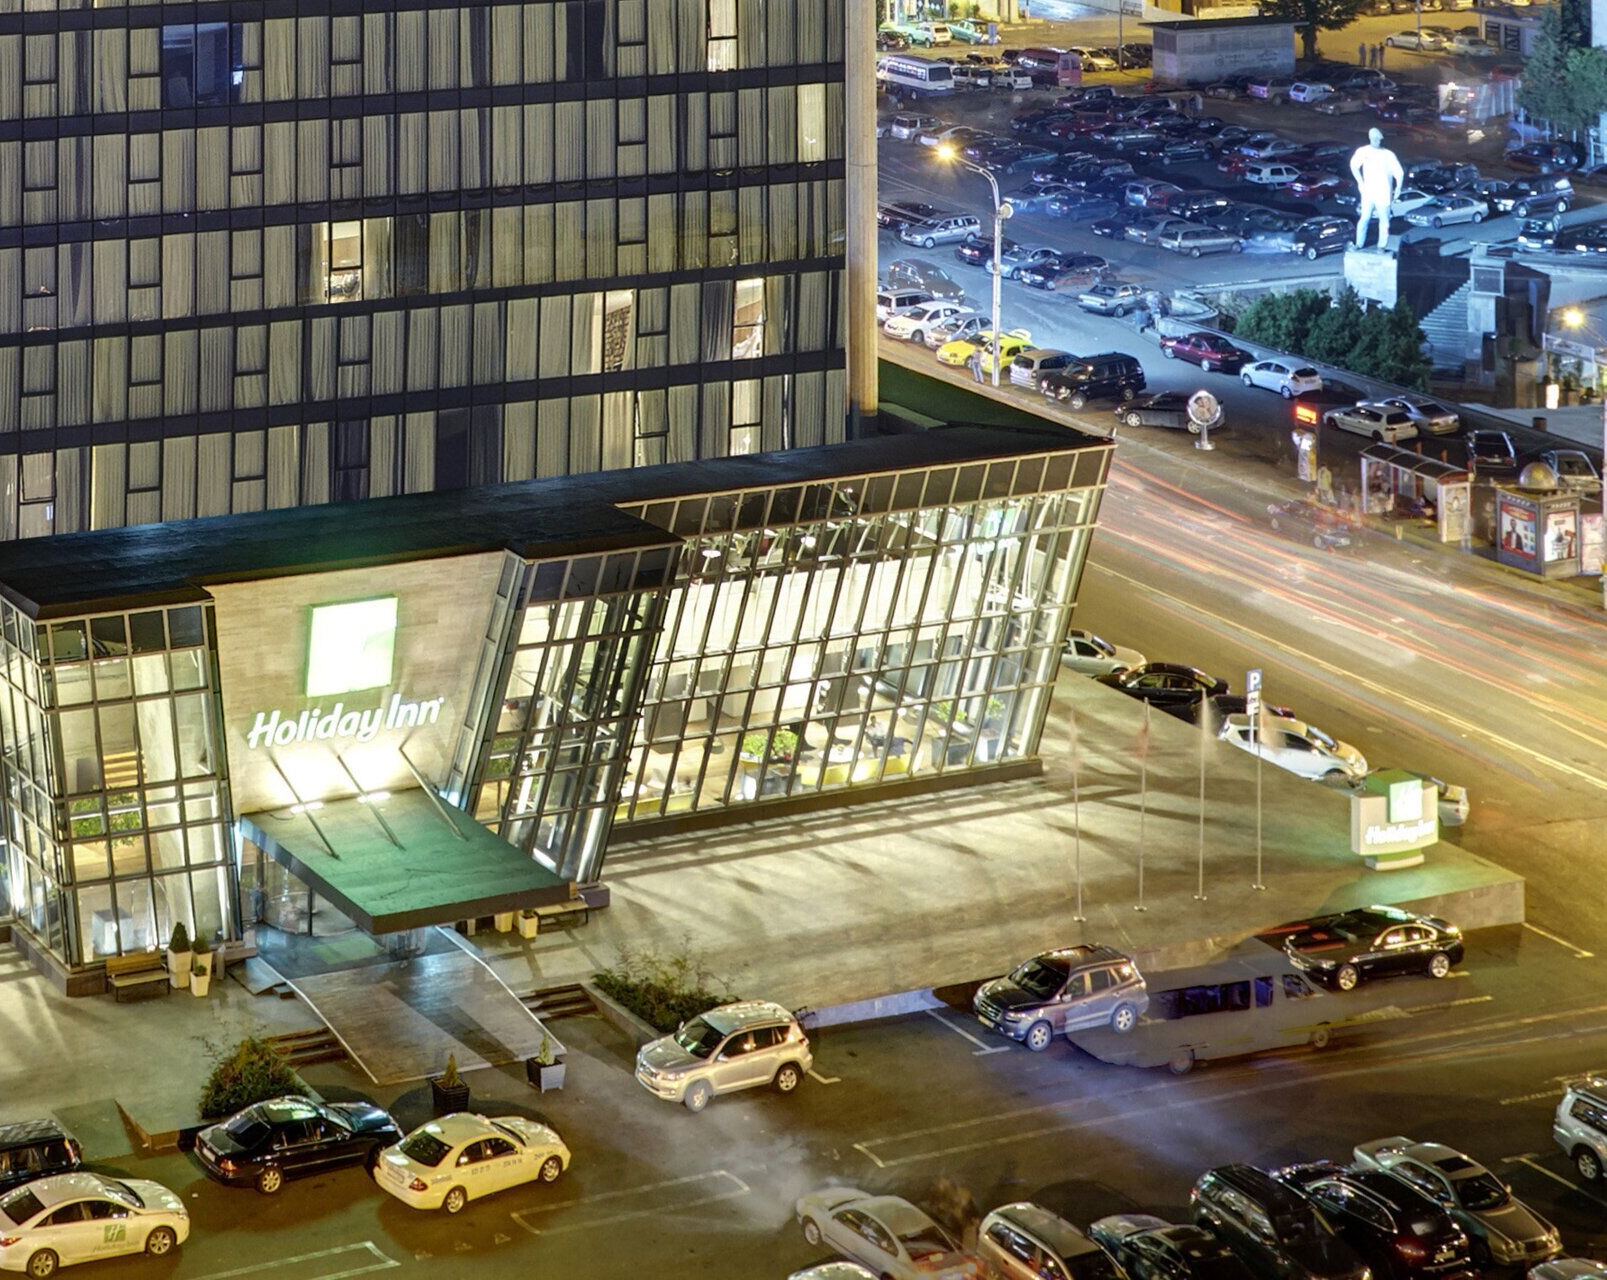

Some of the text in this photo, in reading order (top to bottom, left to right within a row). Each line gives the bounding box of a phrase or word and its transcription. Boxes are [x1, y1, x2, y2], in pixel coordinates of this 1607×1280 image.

[1249, 671, 1260, 691] P
[246, 692, 440, 749] Holiday Inn
